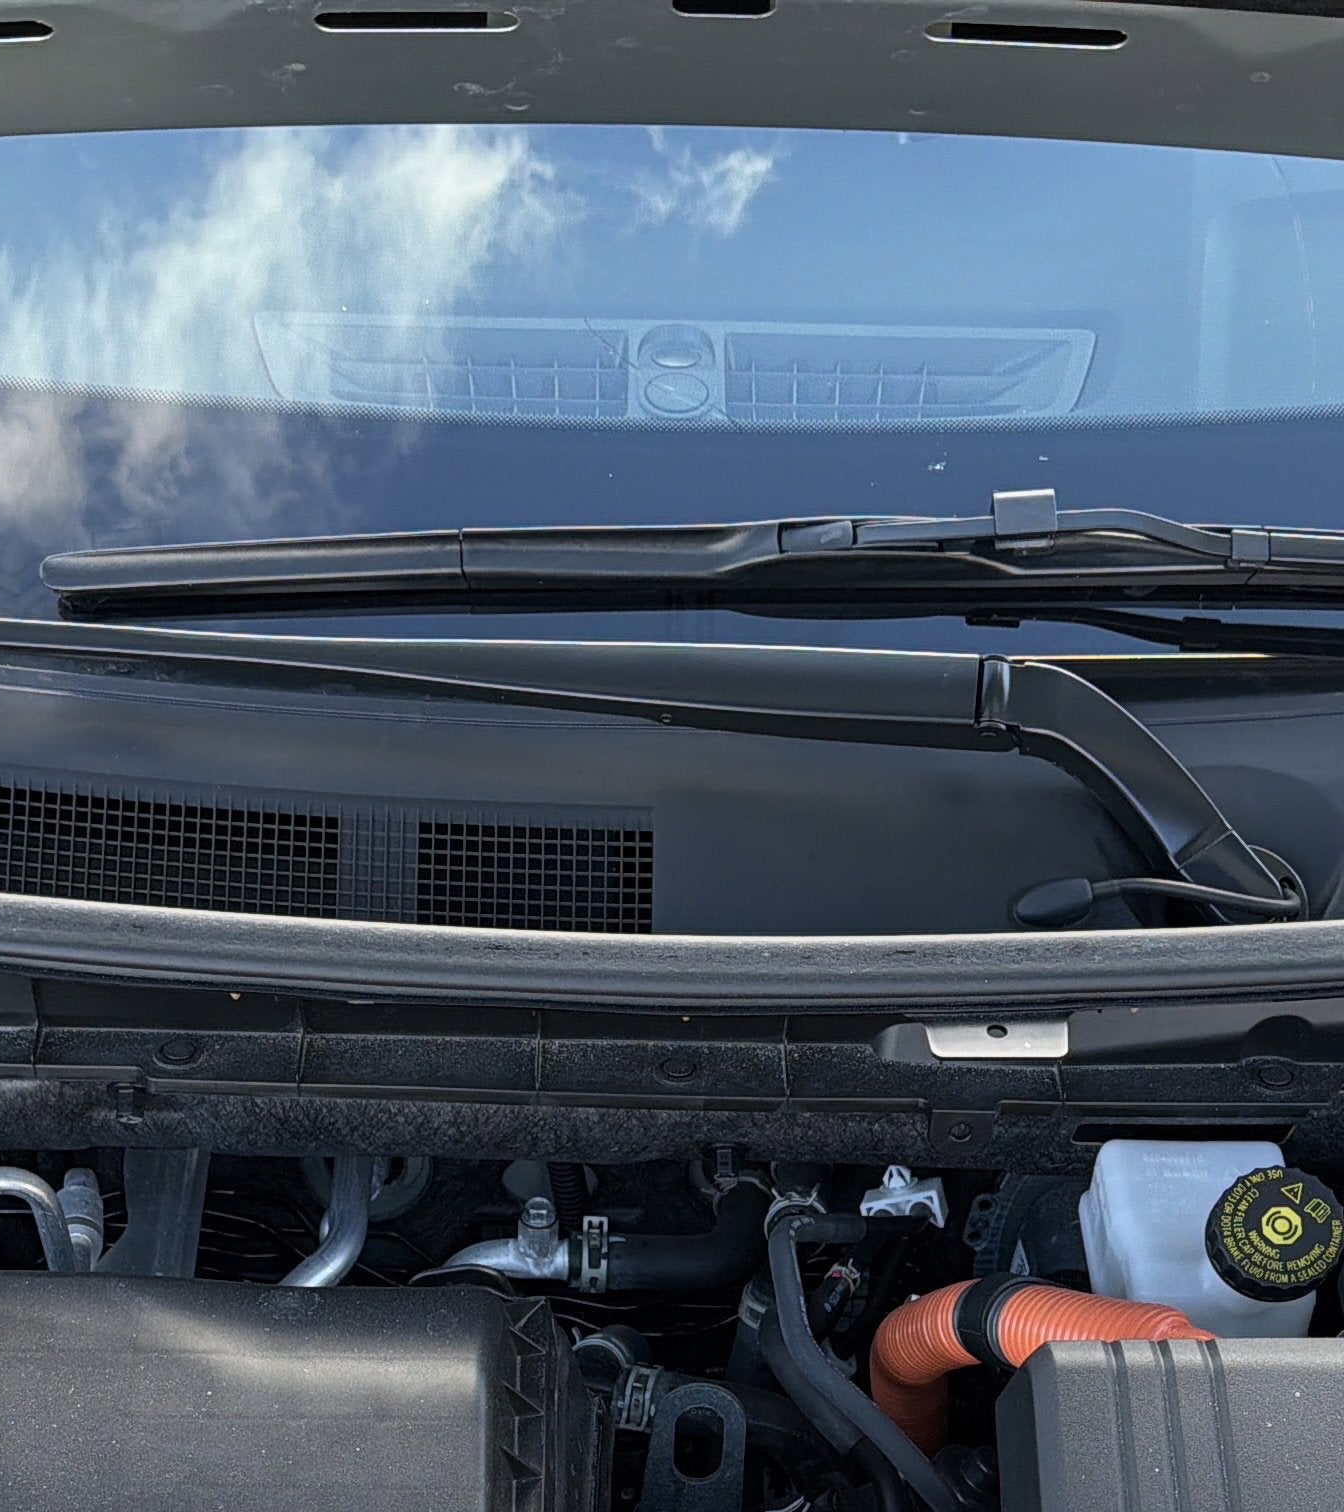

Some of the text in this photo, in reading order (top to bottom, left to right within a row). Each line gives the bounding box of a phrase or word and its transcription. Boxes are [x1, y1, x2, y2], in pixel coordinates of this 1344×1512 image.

[1245, 1172, 1266, 1187] ONLY
[1267, 1169, 1284, 1180] USE
[1222, 1201, 1235, 1214] OR
[1233, 1188, 1325, 1272] CLEAN FILLER CAP BEFORE REMOVING
[1322, 1219, 1343, 1261] CONTAINER
[1223, 1235, 1244, 1261] BRAKE
[1248, 1230, 1281, 1260] WARNING
[1241, 1259, 1264, 1279] FLUID
[1263, 1272, 1289, 1284] FROM
[1290, 1273, 1297, 1284] A
[1299, 1259, 1327, 1281] SEALED
